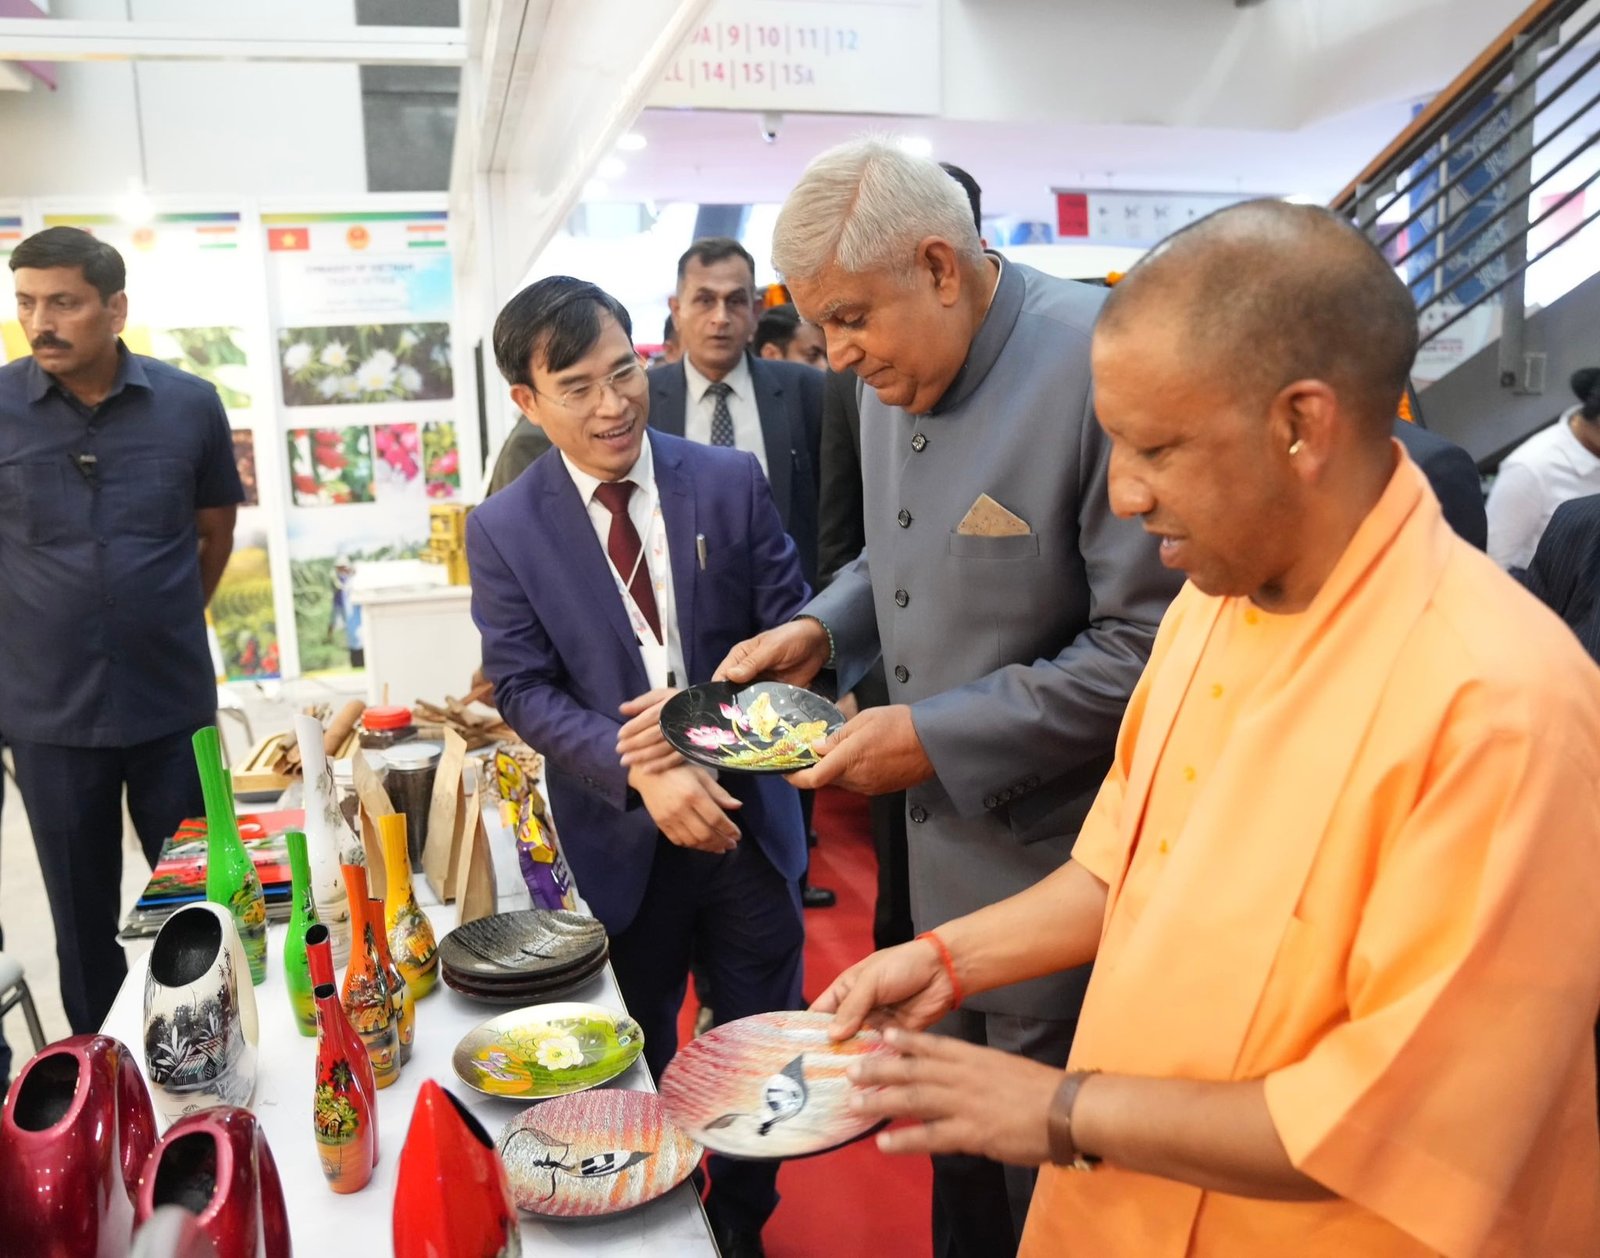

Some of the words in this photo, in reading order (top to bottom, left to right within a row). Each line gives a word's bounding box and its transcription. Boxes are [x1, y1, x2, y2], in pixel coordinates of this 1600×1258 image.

[728, 25, 741, 46] 9
[757, 26, 780, 47] 10
[797, 28, 818, 49] 11
[836, 29, 859, 50] 12
[702, 61, 726, 82] 14
[742, 63, 765, 84] 15
